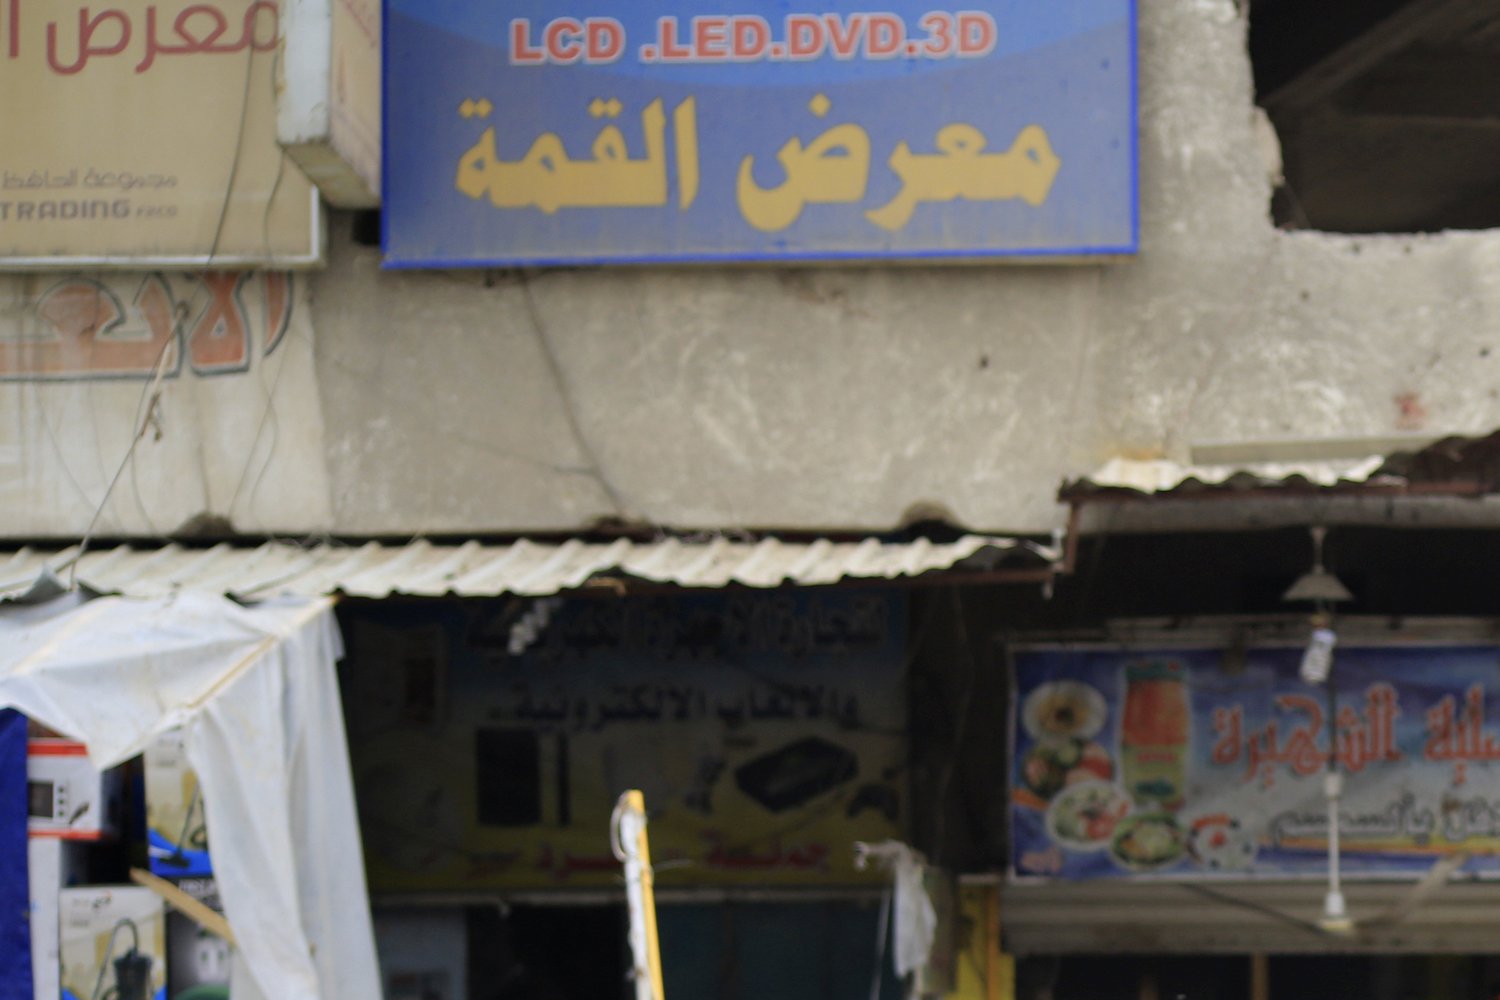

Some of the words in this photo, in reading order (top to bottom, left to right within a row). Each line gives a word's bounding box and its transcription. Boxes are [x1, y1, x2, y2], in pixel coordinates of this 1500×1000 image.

[510, 18, 625, 65] LCD
[455, 95, 700, 214] القمة
[737, 92, 1062, 231] معرض
[1210, 682, 1403, 787] الشهيرة
